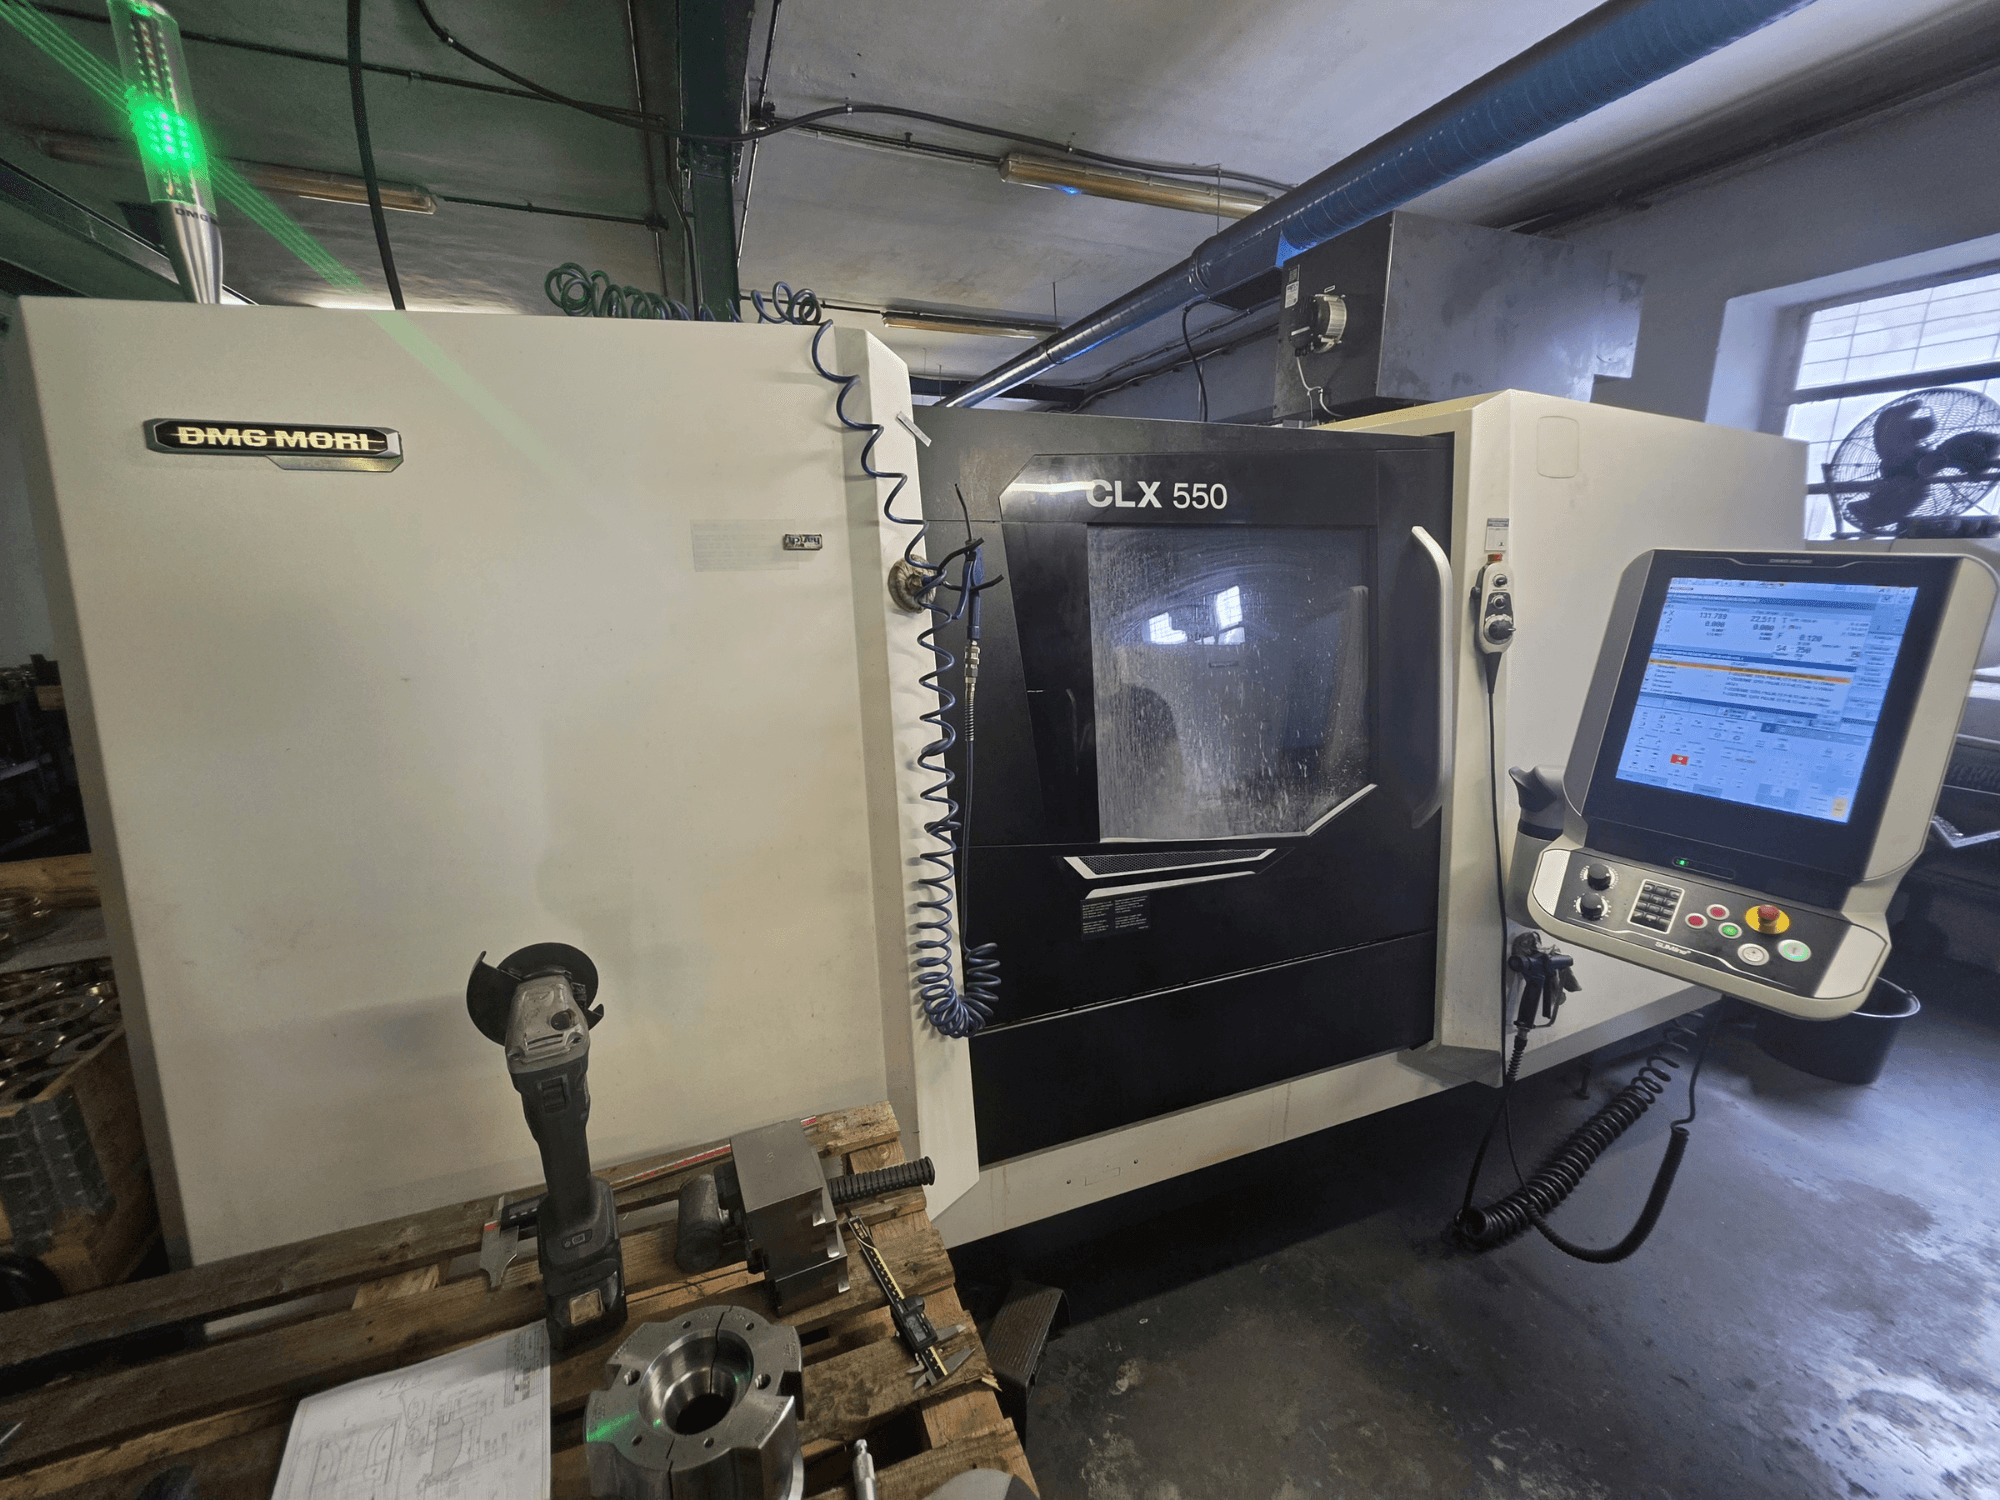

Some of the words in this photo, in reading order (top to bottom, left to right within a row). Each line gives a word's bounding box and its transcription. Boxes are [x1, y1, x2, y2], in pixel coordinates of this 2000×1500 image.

[174, 207, 209, 223] DMG
[177, 426, 267, 447] DMG
[274, 429, 369, 451] MORI
[1086, 479, 1162, 508] CLX
[1172, 482, 1228, 510] 550
